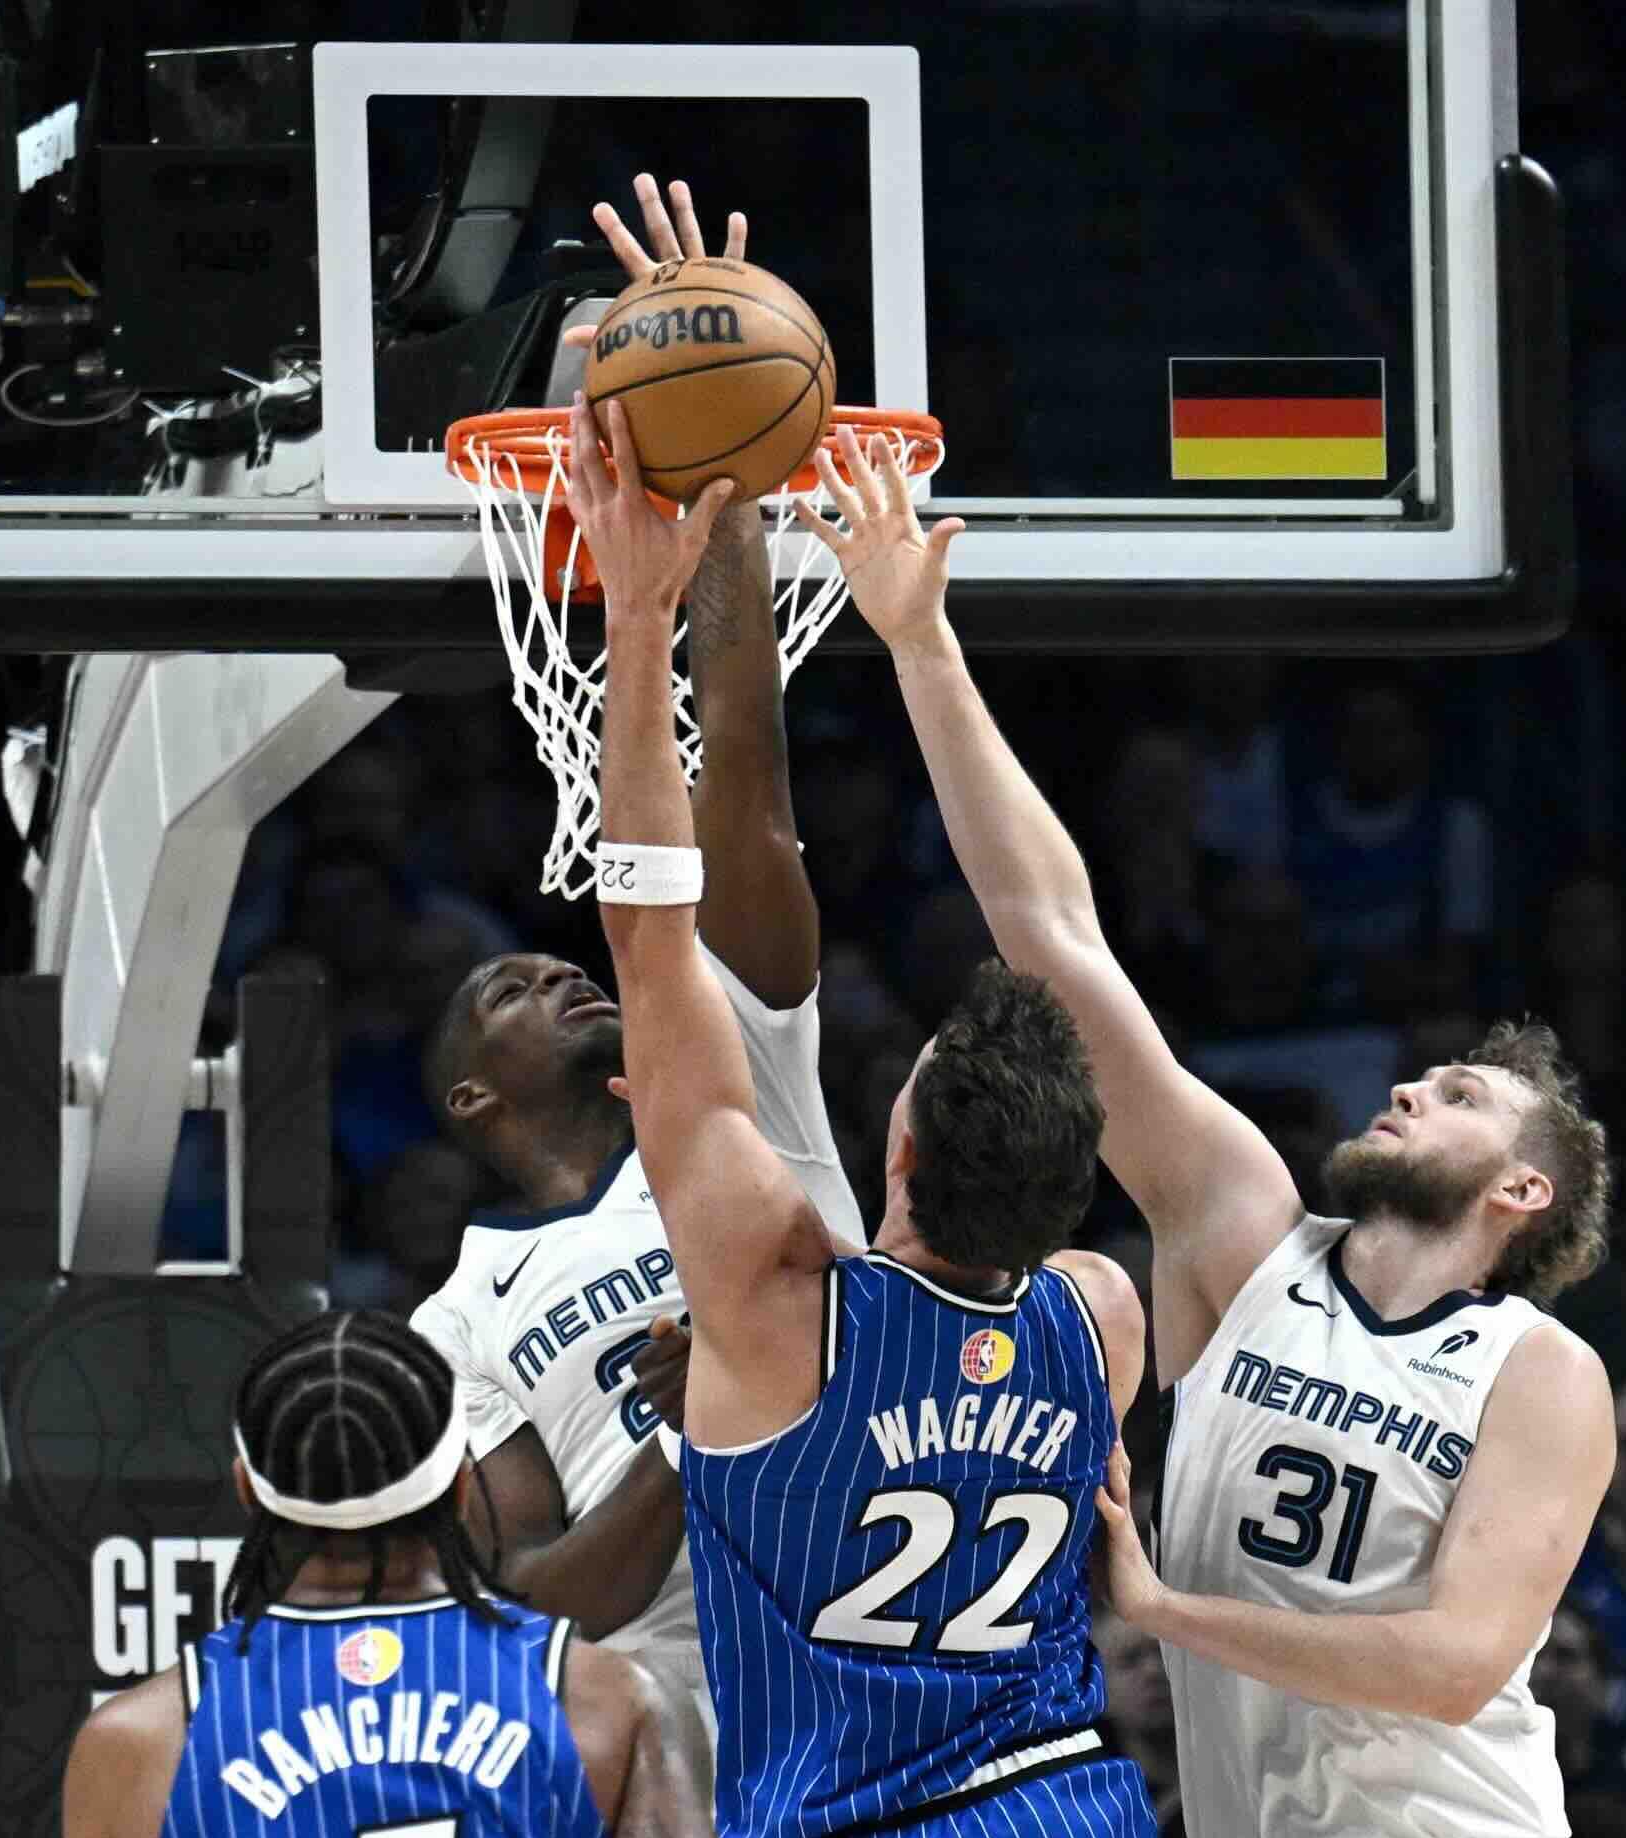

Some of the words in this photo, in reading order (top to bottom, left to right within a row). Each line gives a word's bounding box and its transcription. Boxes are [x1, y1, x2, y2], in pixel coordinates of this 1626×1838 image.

[596, 302, 744, 363] Wilson
[868, 1393, 1077, 1474] WAGNER
[1221, 1350, 1476, 1481] MEMPHIS
[1406, 1358, 1475, 1390] Robinhood
[810, 1489, 1070, 1653] 22
[1238, 1443, 1379, 1585] 31
[220, 1691, 531, 1820] BANCHERO
